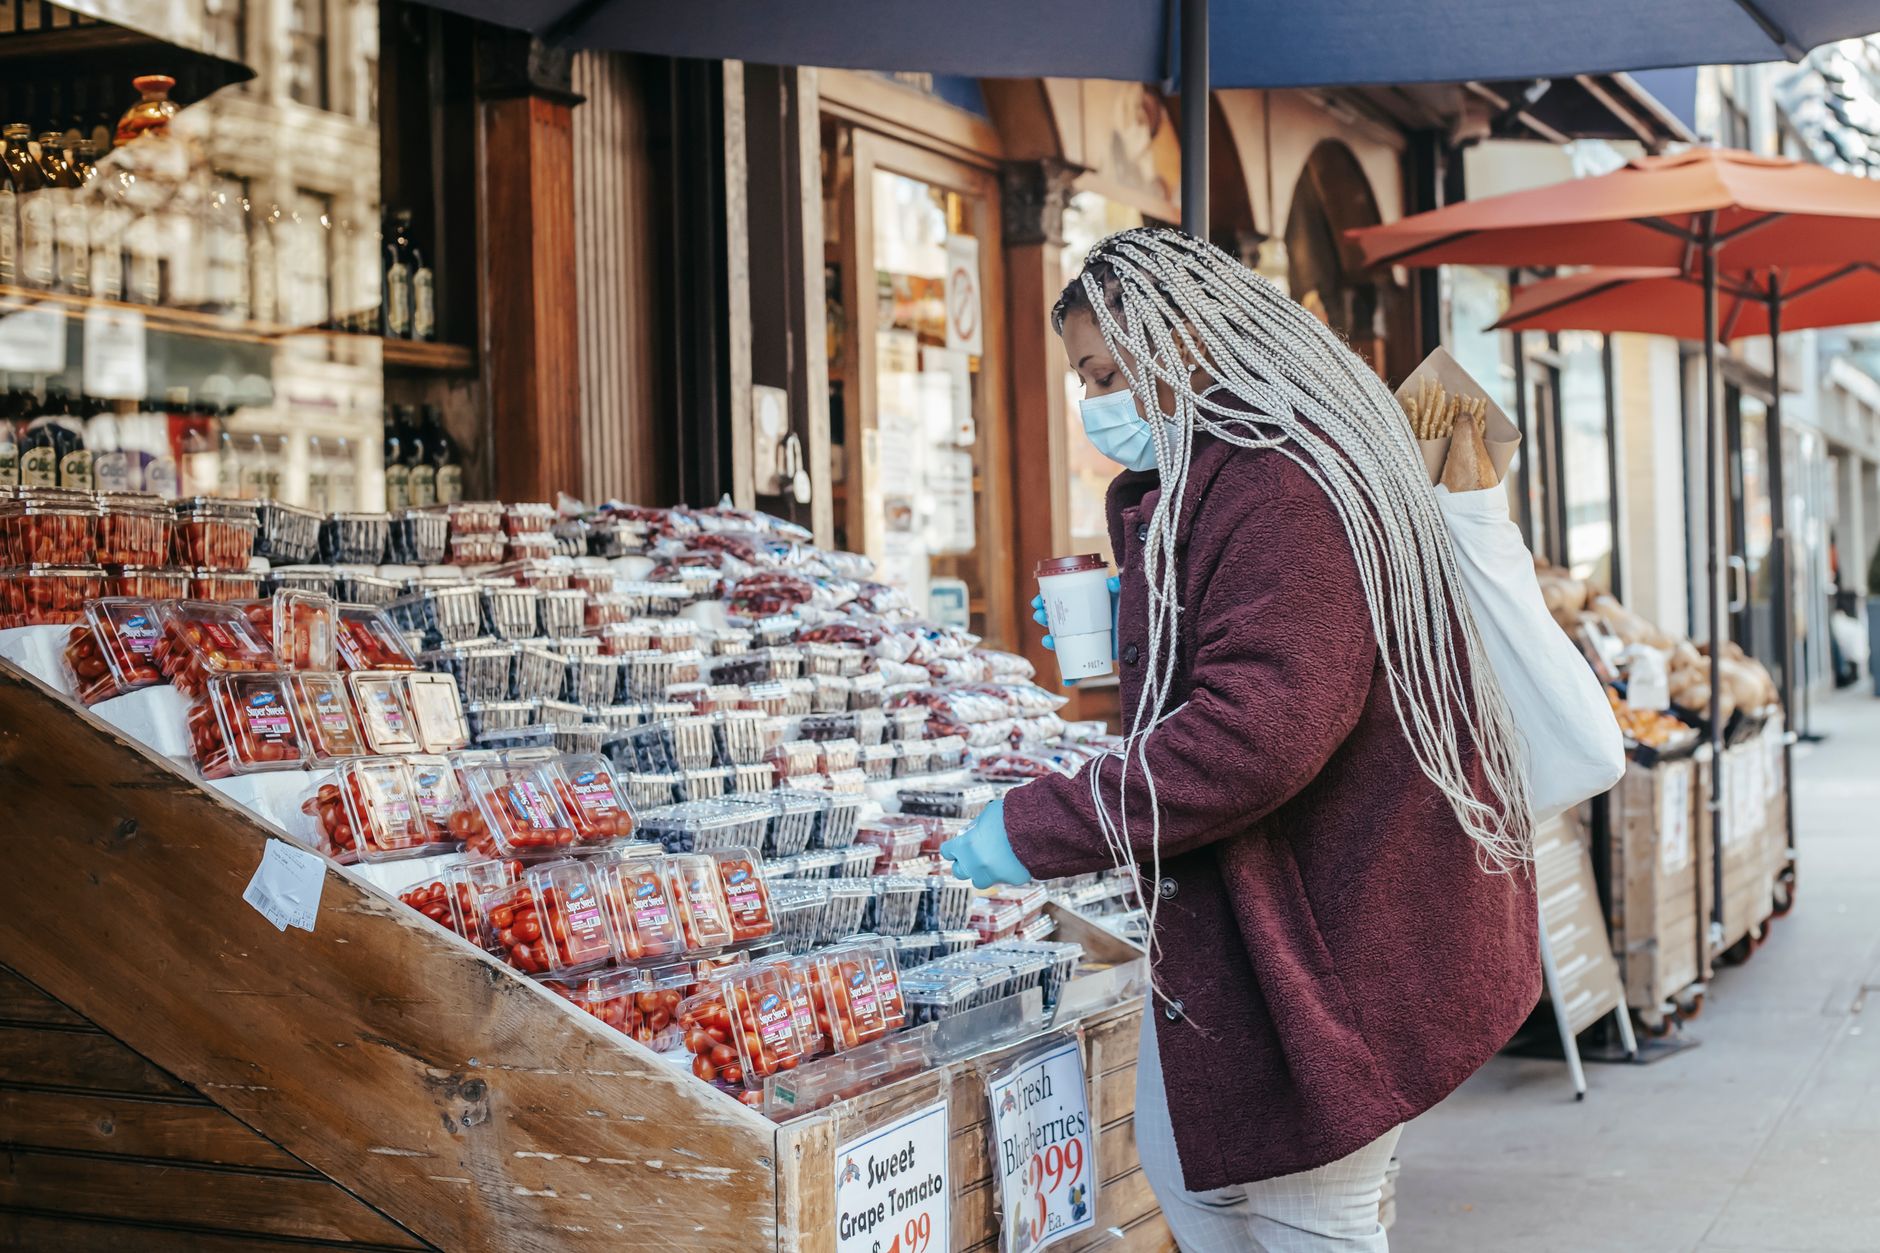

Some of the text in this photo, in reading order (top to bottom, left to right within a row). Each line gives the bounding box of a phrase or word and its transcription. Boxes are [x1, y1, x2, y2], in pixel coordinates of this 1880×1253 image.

[246, 705, 285, 718] Super Sweet
[572, 782, 609, 795] Super Sweet
[727, 882, 757, 897] Super Sweet
[566, 896, 596, 914] Super Sweet
[633, 895, 665, 911] Super Sweet
[849, 984, 873, 1000] Super Sweet
[759, 1006, 787, 1026] Super Sweet
[1016, 1064, 1053, 1116] Fresh
[1003, 1105, 1085, 1177] Blueberries
[867, 1140, 915, 1189] Sweet
[840, 1173, 943, 1241] Grape Tomato
[1047, 1212, 1066, 1232] Ea.
